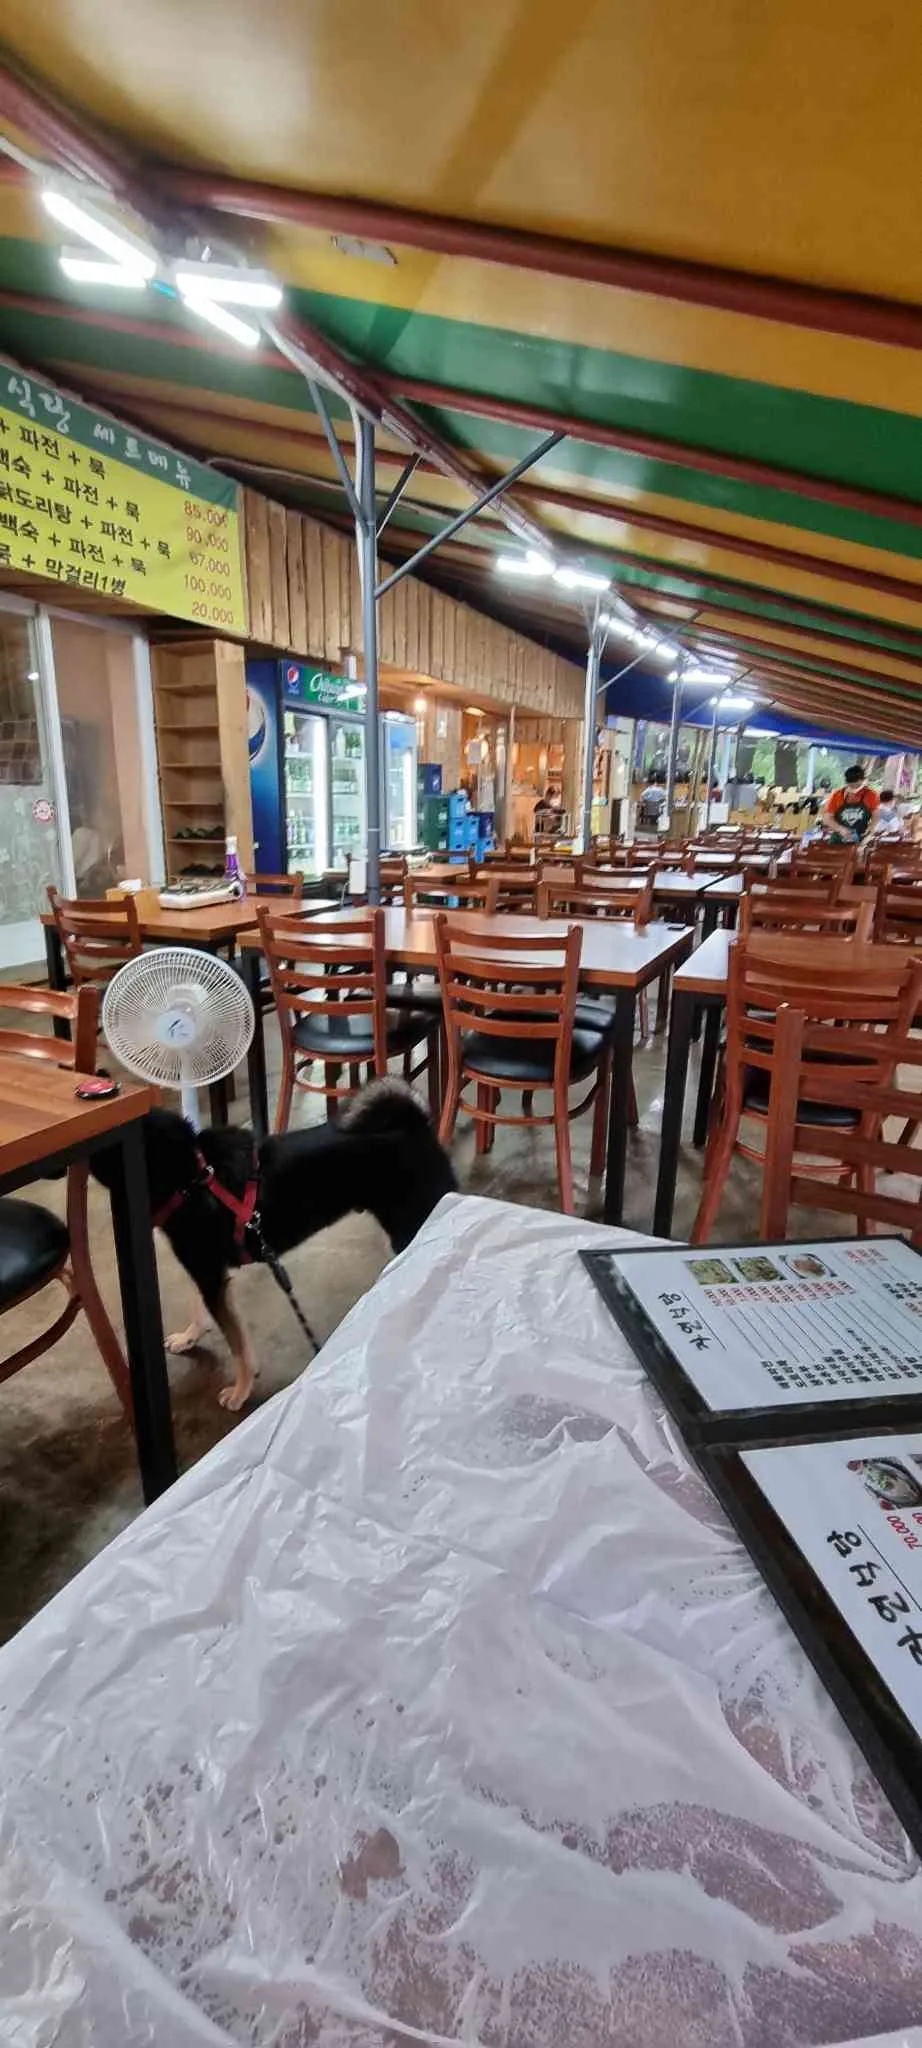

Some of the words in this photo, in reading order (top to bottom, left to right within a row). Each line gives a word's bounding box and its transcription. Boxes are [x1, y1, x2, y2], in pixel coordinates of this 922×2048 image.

[7, 376, 71, 434] 식당
[18, 425, 60, 460] 파전
[63, 476, 98, 506] 파전
[0, 511, 39, 544] 백숙
[69, 537, 106, 564] 파전
[100, 520, 134, 547] 파전
[657, 1292, 712, 1351] 자연식당
